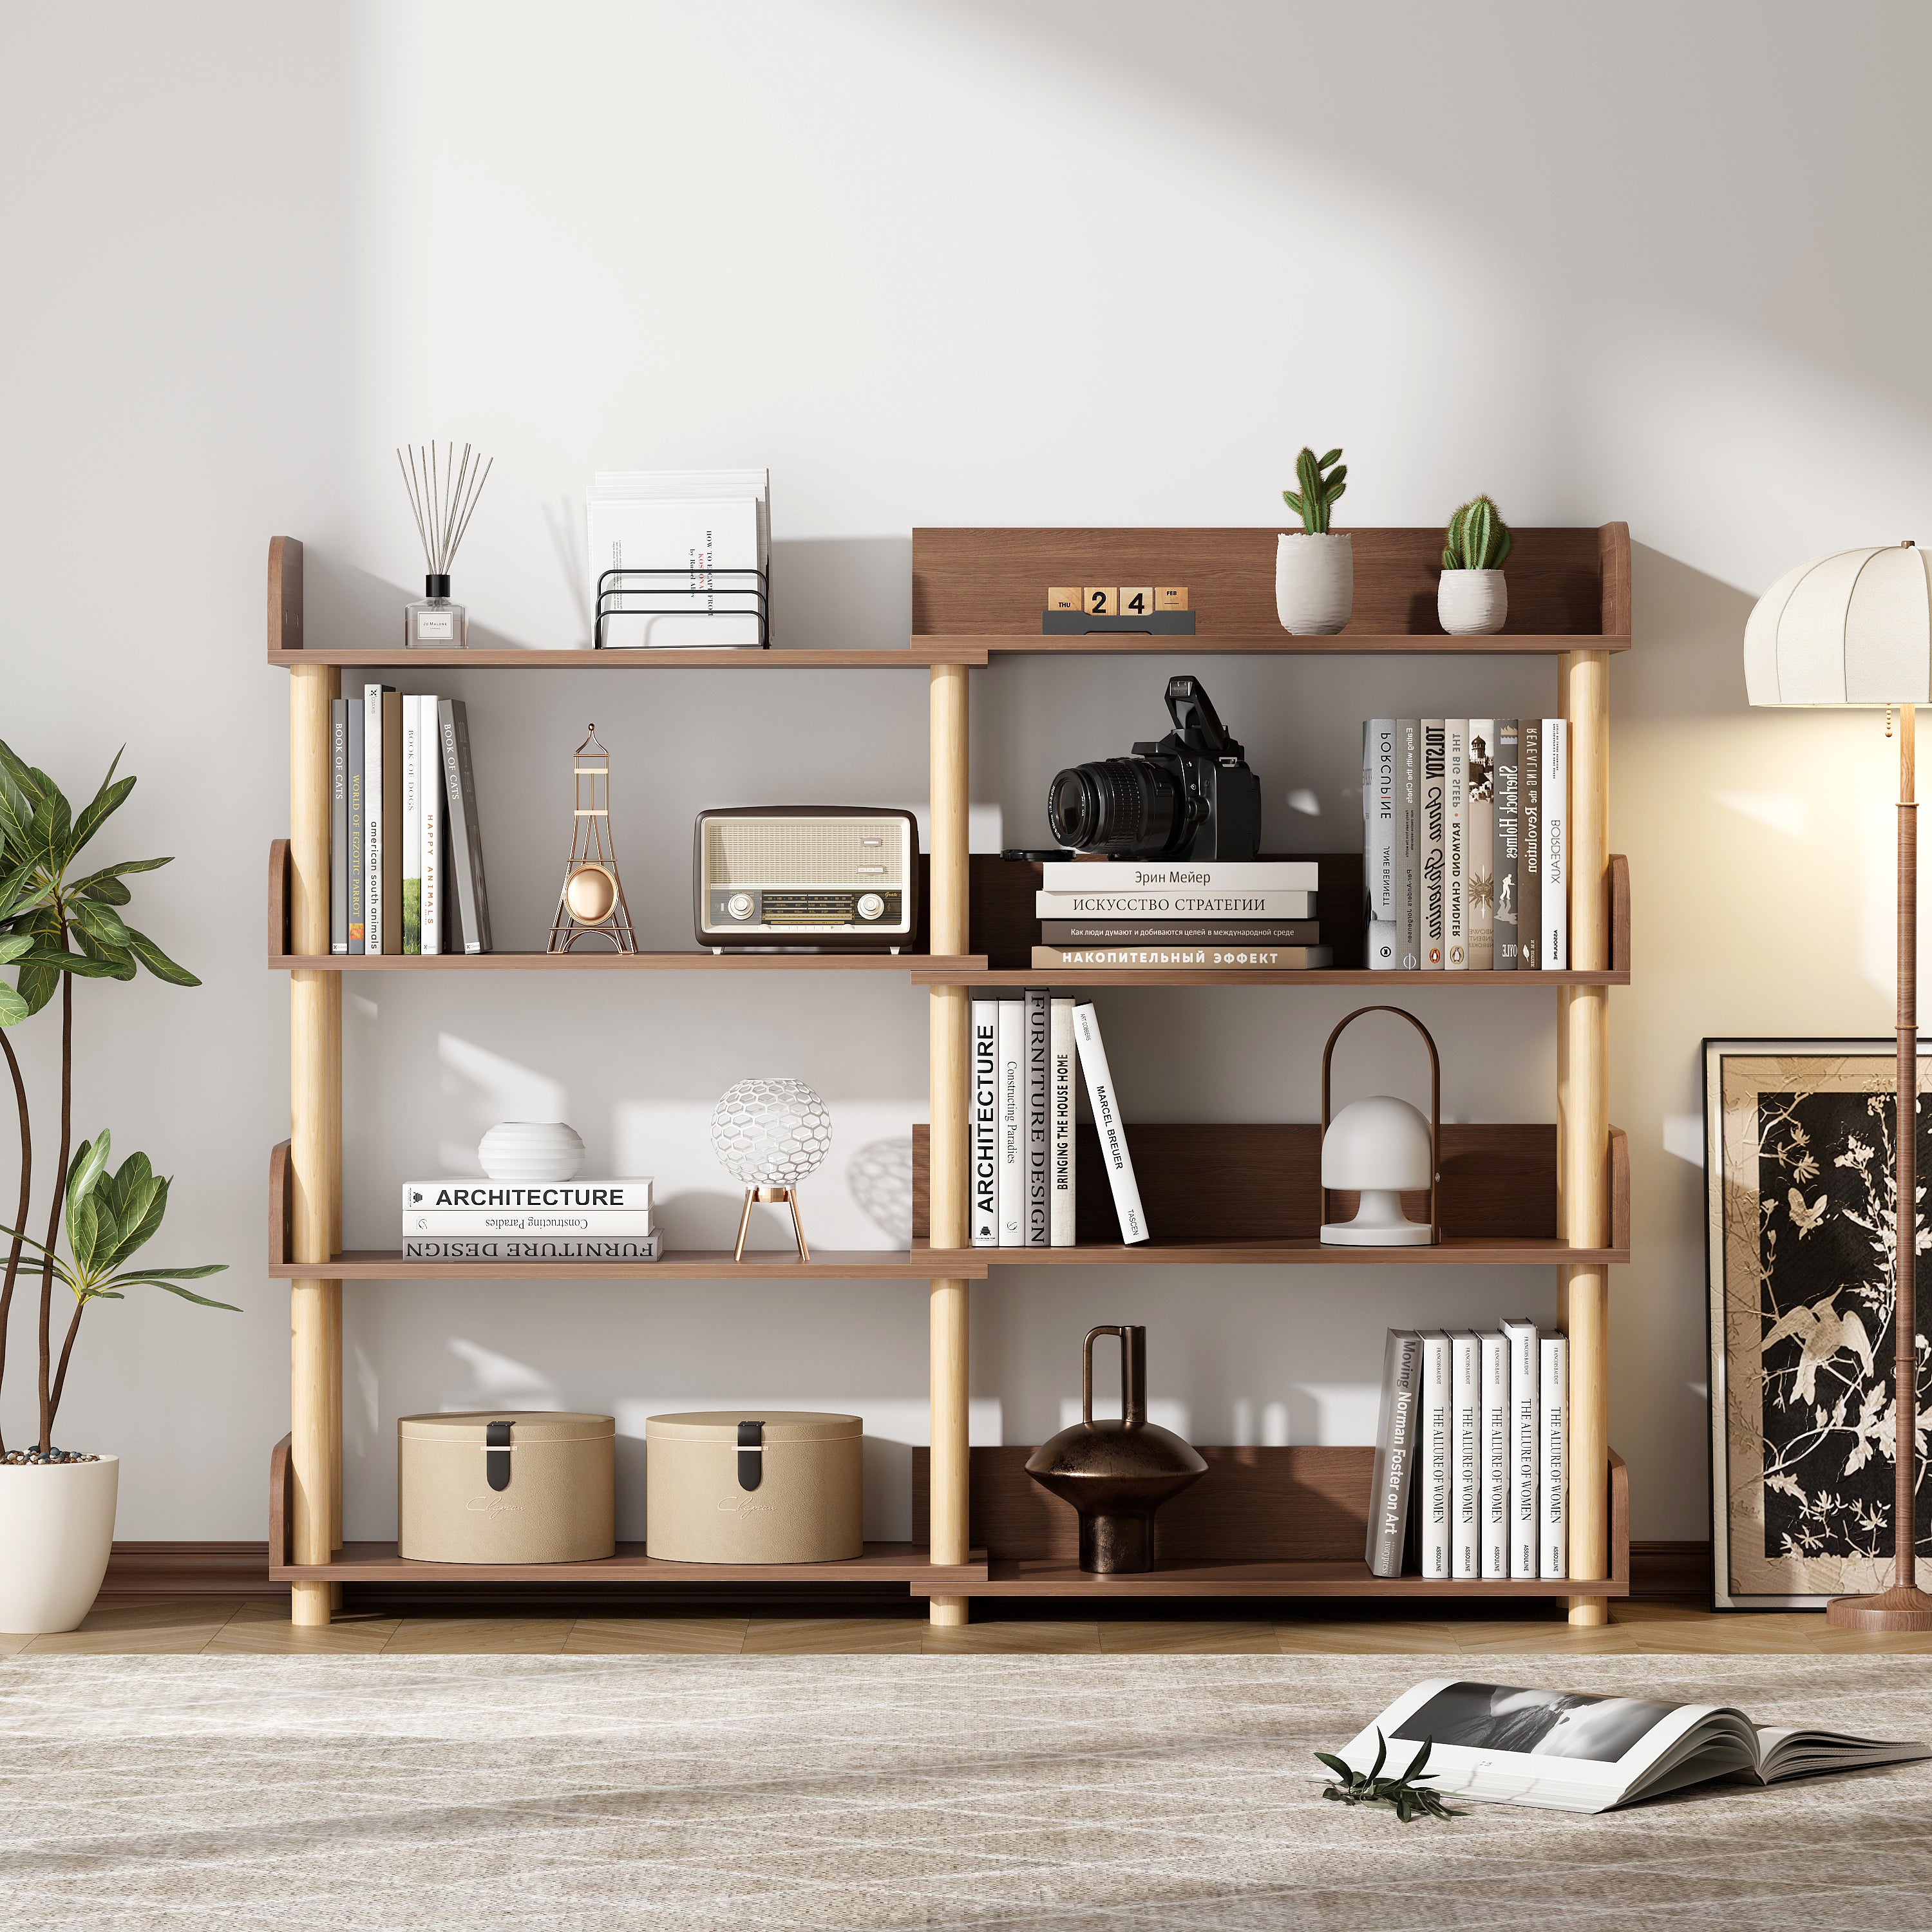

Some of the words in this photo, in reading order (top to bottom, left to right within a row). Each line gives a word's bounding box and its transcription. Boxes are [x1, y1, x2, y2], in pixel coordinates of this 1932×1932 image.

[707, 551, 713, 562] TO
[335, 723, 343, 753] BOOK
[444, 723, 455, 754] BOOK
[335, 756, 343, 772] OF
[408, 762, 414, 777] OF
[448, 757, 456, 772] OF
[335, 774, 343, 800] CATS
[450, 773, 460, 800] CATS
[352, 814, 360, 827] OF
[1135, 871, 1166, 886] Эрин
[1170, 871, 1211, 886] Мейер
[1073, 898, 1170, 911] ИСКУССТВО
[1175, 898, 1266, 911] СТРАТЕГИИ
[1140, 928, 1183, 936] добиваются
[1184, 928, 1206, 936] целей
[1213, 929, 1271, 937] международной
[1062, 950, 1206, 964] НАКОПИТЕЛЬНЫЙ
[1213, 952, 1278, 964] ЭФФЕКТ
[1031, 996, 1045, 1142] FURNITURE
[1057, 1054, 1068, 1083] HOME
[1004, 1061, 1017, 1122] Constructing
[1057, 1085, 1068, 1119] HOUSE
[978, 1025, 994, 1213] ARCHITECTURE
[1057, 1120, 1068, 1141] THE
[1096, 1085, 1110, 1128] MARCEL
[1106, 1128, 1124, 1170] BREUER
[1007, 1124, 1018, 1164] Paradies
[1057, 1142, 1068, 1190] BRINGING
[435, 1189, 624, 1206] ARCHITECTURE
[1031, 1150, 1045, 1243] DESIGN
[486, 1217, 525, 1229] Paradies
[528, 1217, 588, 1229] Constructing
[1127, 1209, 1139, 1236] TASCEN
[406, 1243, 498, 1256] DESIGN
[507, 1243, 653, 1256] FURNITURE
[1396, 1341, 1416, 1389] Moving
[1394, 1392, 1412, 1445] Norman
[1434, 1406, 1444, 1427] THE
[1463, 1406, 1473, 1427] THE
[1492, 1406, 1502, 1427] THE
[1521, 1398, 1531, 1419] THE
[1550, 1406, 1561, 1427] THE
[1434, 1429, 1444, 1468] ALLURE
[1463, 1429, 1473, 1468] ALLURE
[1492, 1429, 1502, 1468] ALLURE
[1521, 1421, 1531, 1462] ALLURE
[1550, 1429, 1561, 1468] ALLURE
[1390, 1448, 1406, 1492] Foster
[1434, 1470, 1444, 1483] OF
[1463, 1470, 1473, 1483] OF
[1492, 1470, 1502, 1483] OF
[1521, 1464, 1531, 1479] OF
[1550, 1470, 1561, 1483] OF
[1387, 1493, 1397, 1510] on
[1434, 1484, 1444, 1524] WOMEN
[1463, 1484, 1473, 1524] WOMEN
[1492, 1484, 1502, 1524] WOMEN
[1521, 1481, 1531, 1521] WOMEN
[1550, 1484, 1561, 1524] WOMEN
[1385, 1511, 1398, 1535] Art
